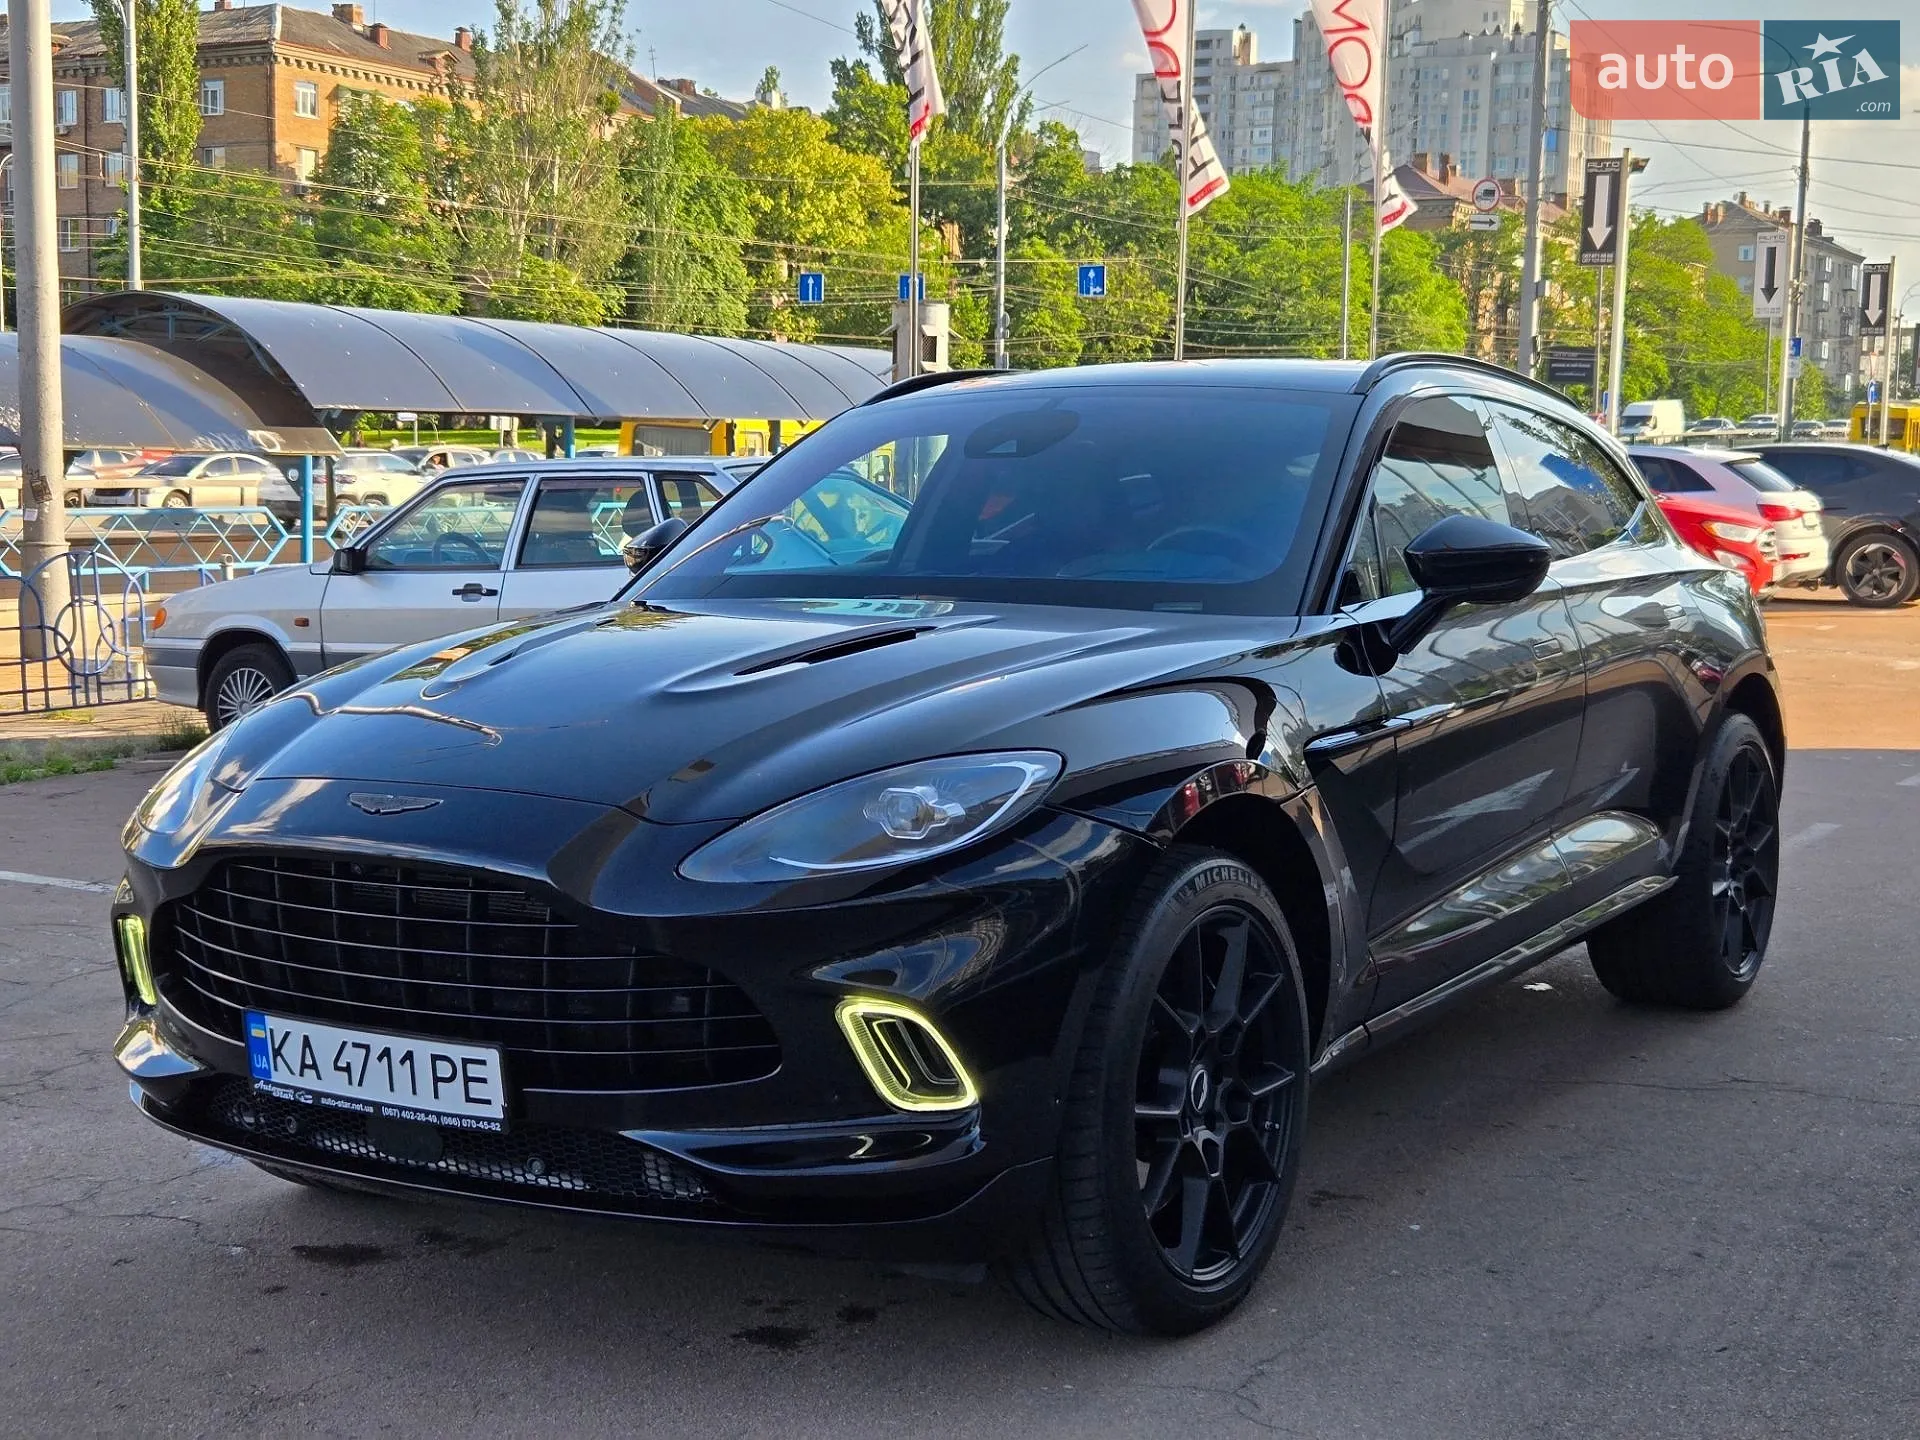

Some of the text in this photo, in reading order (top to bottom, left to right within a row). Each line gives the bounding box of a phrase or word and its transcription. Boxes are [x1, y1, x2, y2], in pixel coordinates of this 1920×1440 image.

[1194, 866, 1258, 892] MICHELIN
[254, 1056, 269, 1070] UA
[269, 1027, 492, 1105] KA 4711 PE
